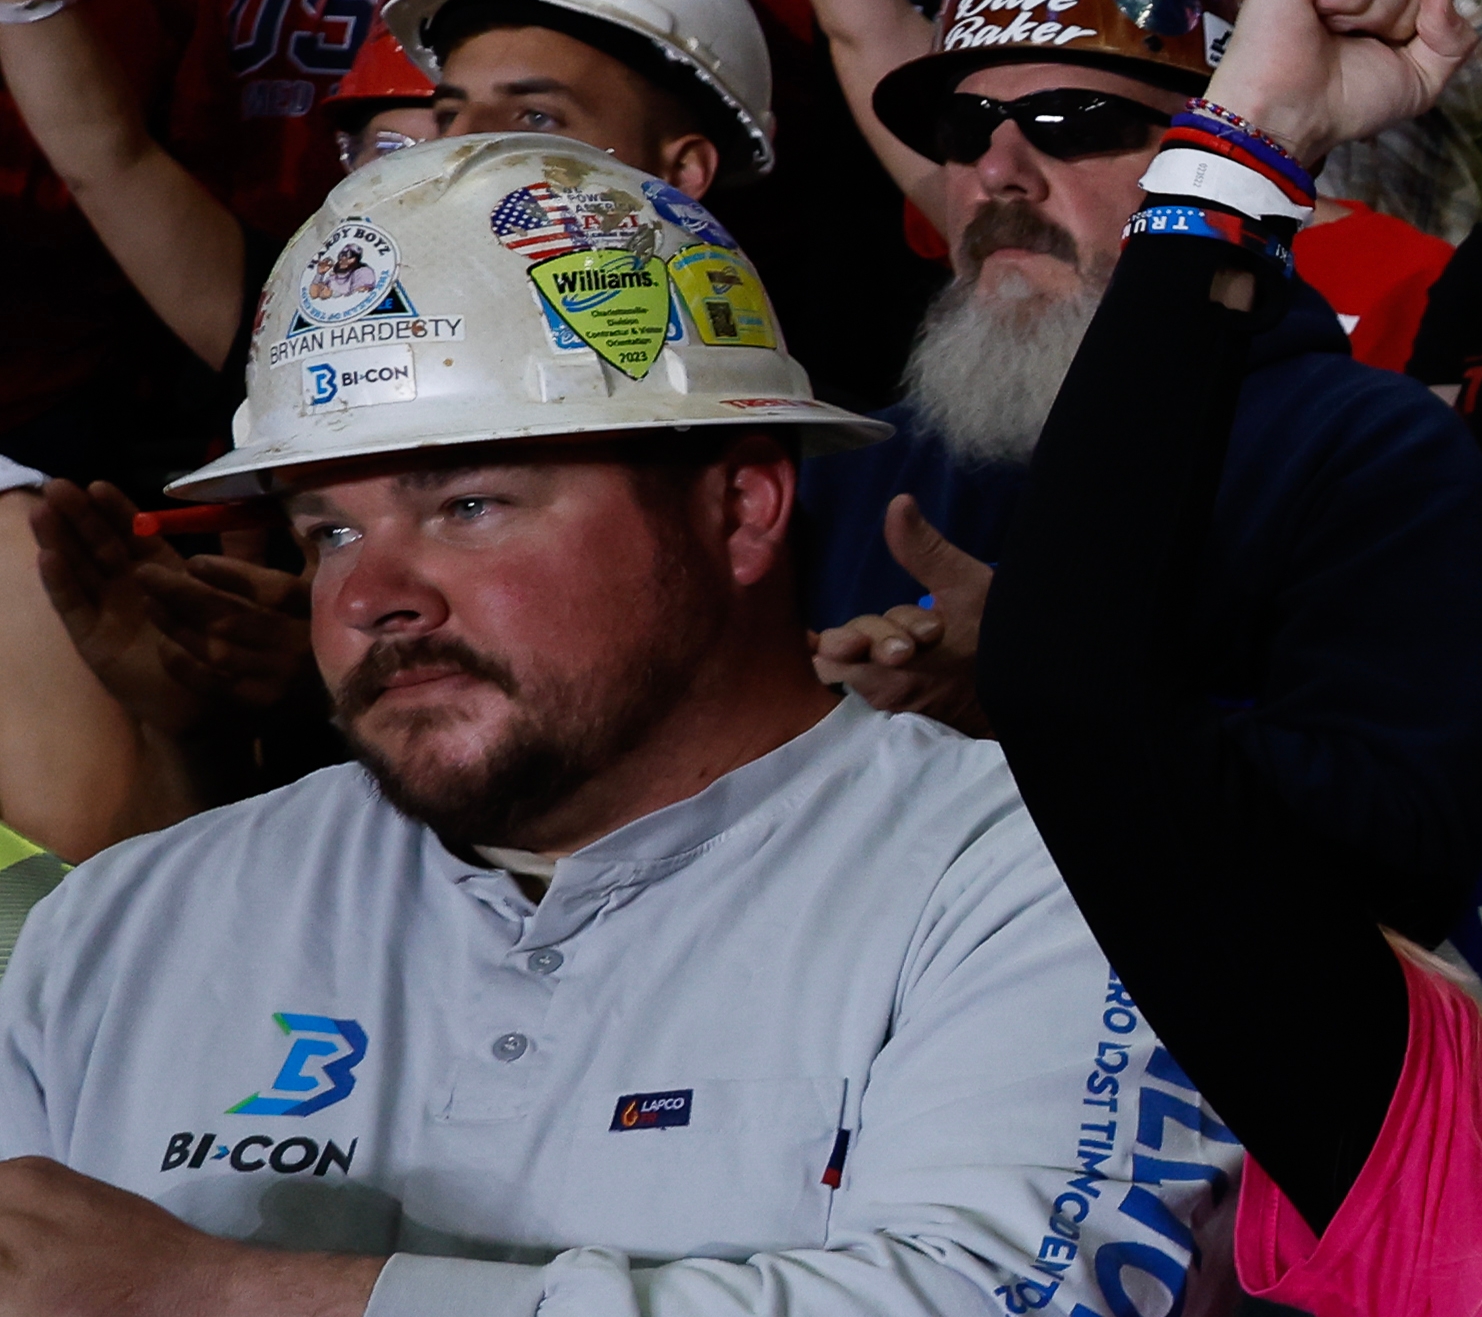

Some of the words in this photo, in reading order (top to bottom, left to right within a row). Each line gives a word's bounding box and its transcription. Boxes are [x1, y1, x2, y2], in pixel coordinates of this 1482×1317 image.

[943, 9, 1098, 51] Baker
[306, 227, 351, 270] HARDY
[353, 227, 391, 257] BOYZ
[269, 332, 324, 366] BRYAN
[330, 318, 463, 348] HARDESTY
[618, 351, 648, 364] 2023
[639, 1097, 686, 1113] LAPCO
